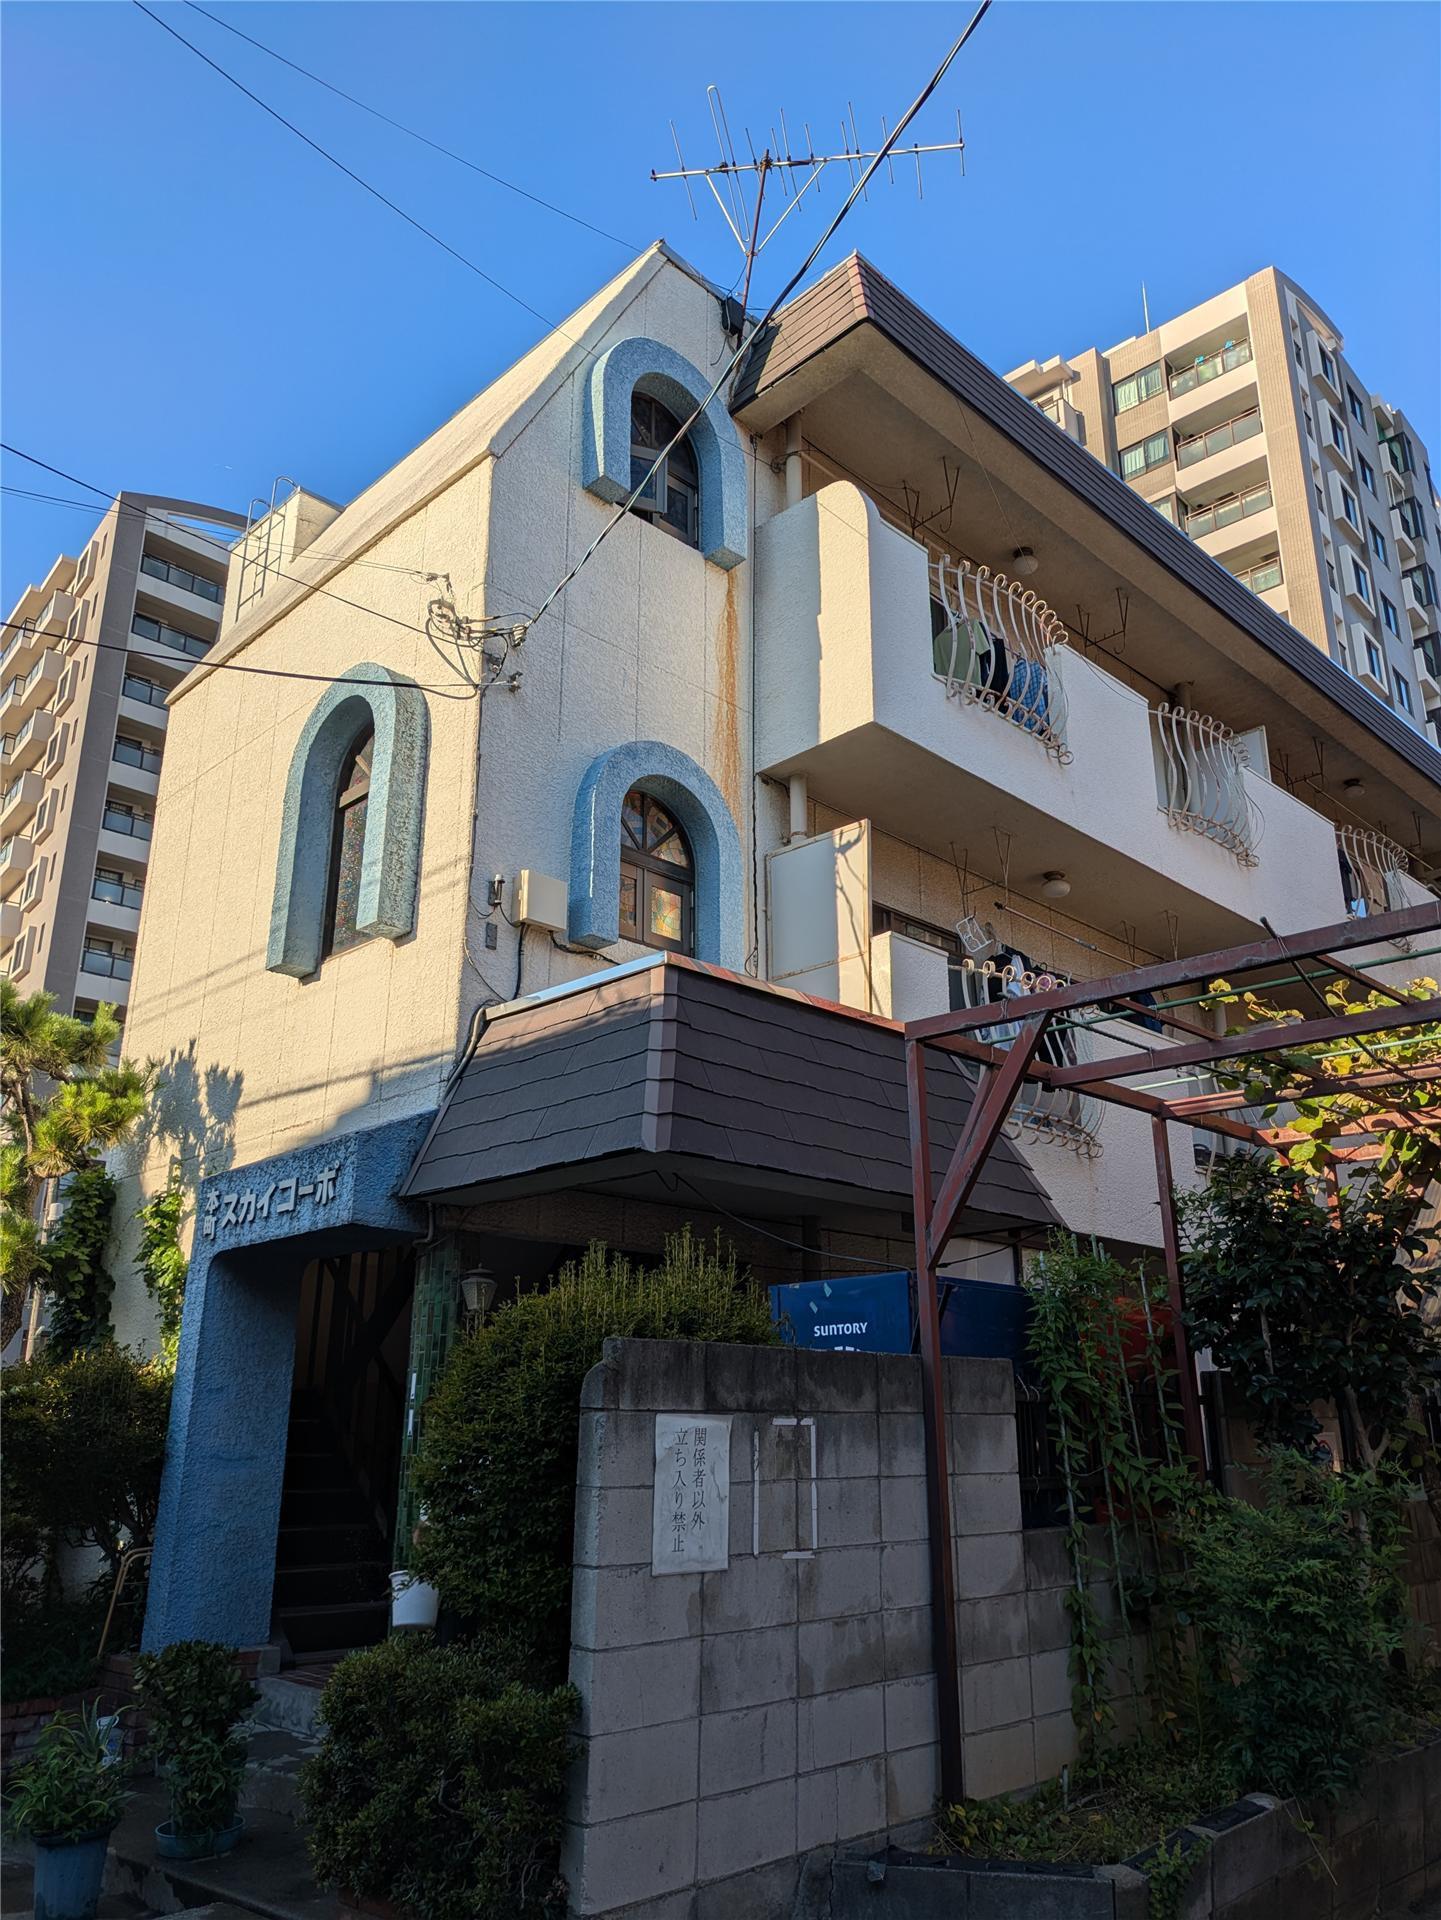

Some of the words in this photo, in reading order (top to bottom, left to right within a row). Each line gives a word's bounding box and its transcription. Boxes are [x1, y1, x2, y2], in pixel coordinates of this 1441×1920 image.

[203, 1188, 221, 1240] 本町
[222, 1160, 340, 1227] スカイコーポ
[814, 1322, 868, 1337] SUNTORY
[671, 1428, 688, 1553] 立ち入り禁止
[692, 1428, 707, 1530] 関係者以外
